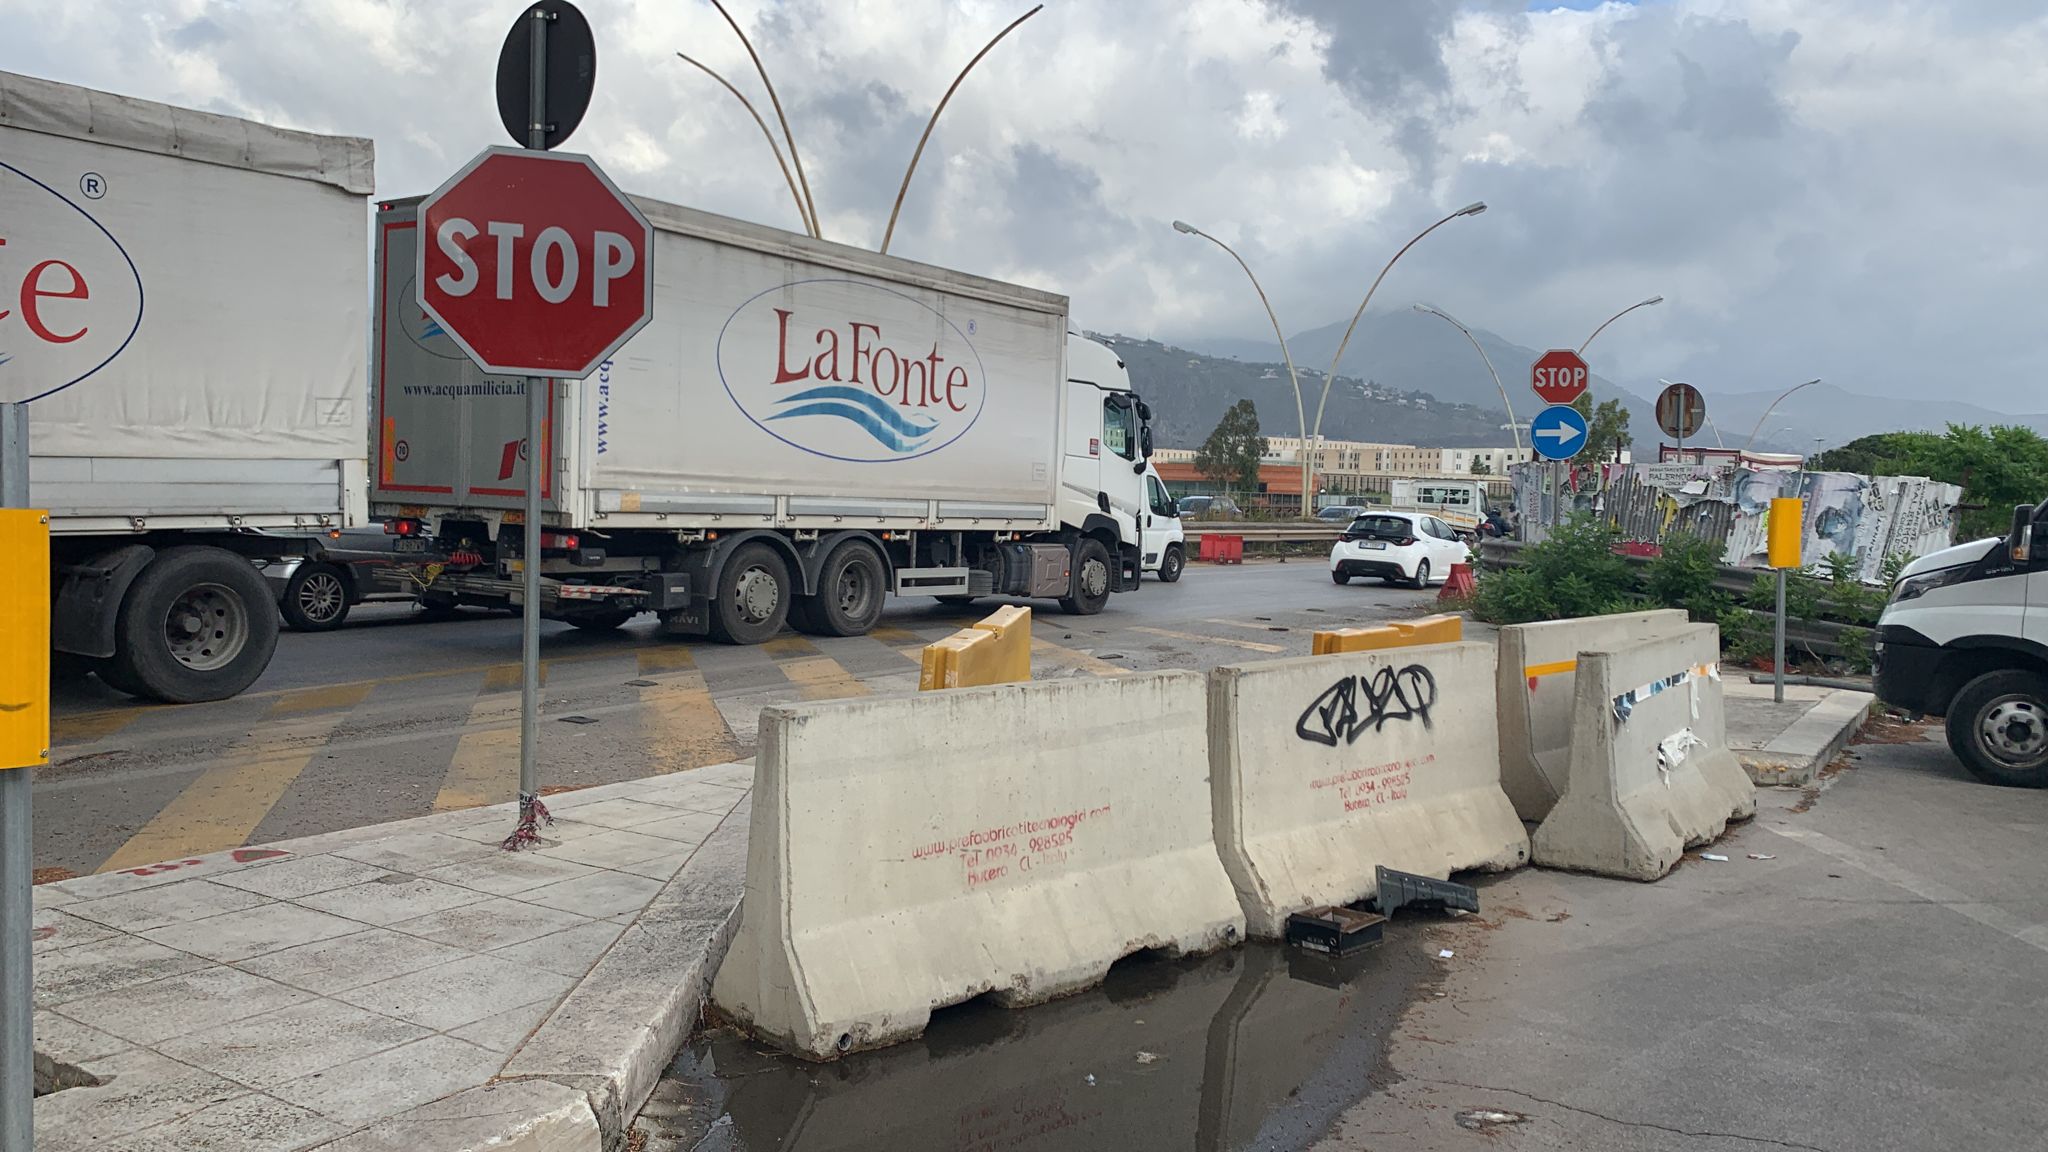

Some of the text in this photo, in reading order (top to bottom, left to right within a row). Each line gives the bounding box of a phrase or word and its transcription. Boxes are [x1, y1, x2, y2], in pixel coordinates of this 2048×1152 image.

[435, 217, 636, 307] STOP
[1535, 367, 1586, 387] STOP
[404, 381, 526, 399] www.acquamilicia.it
